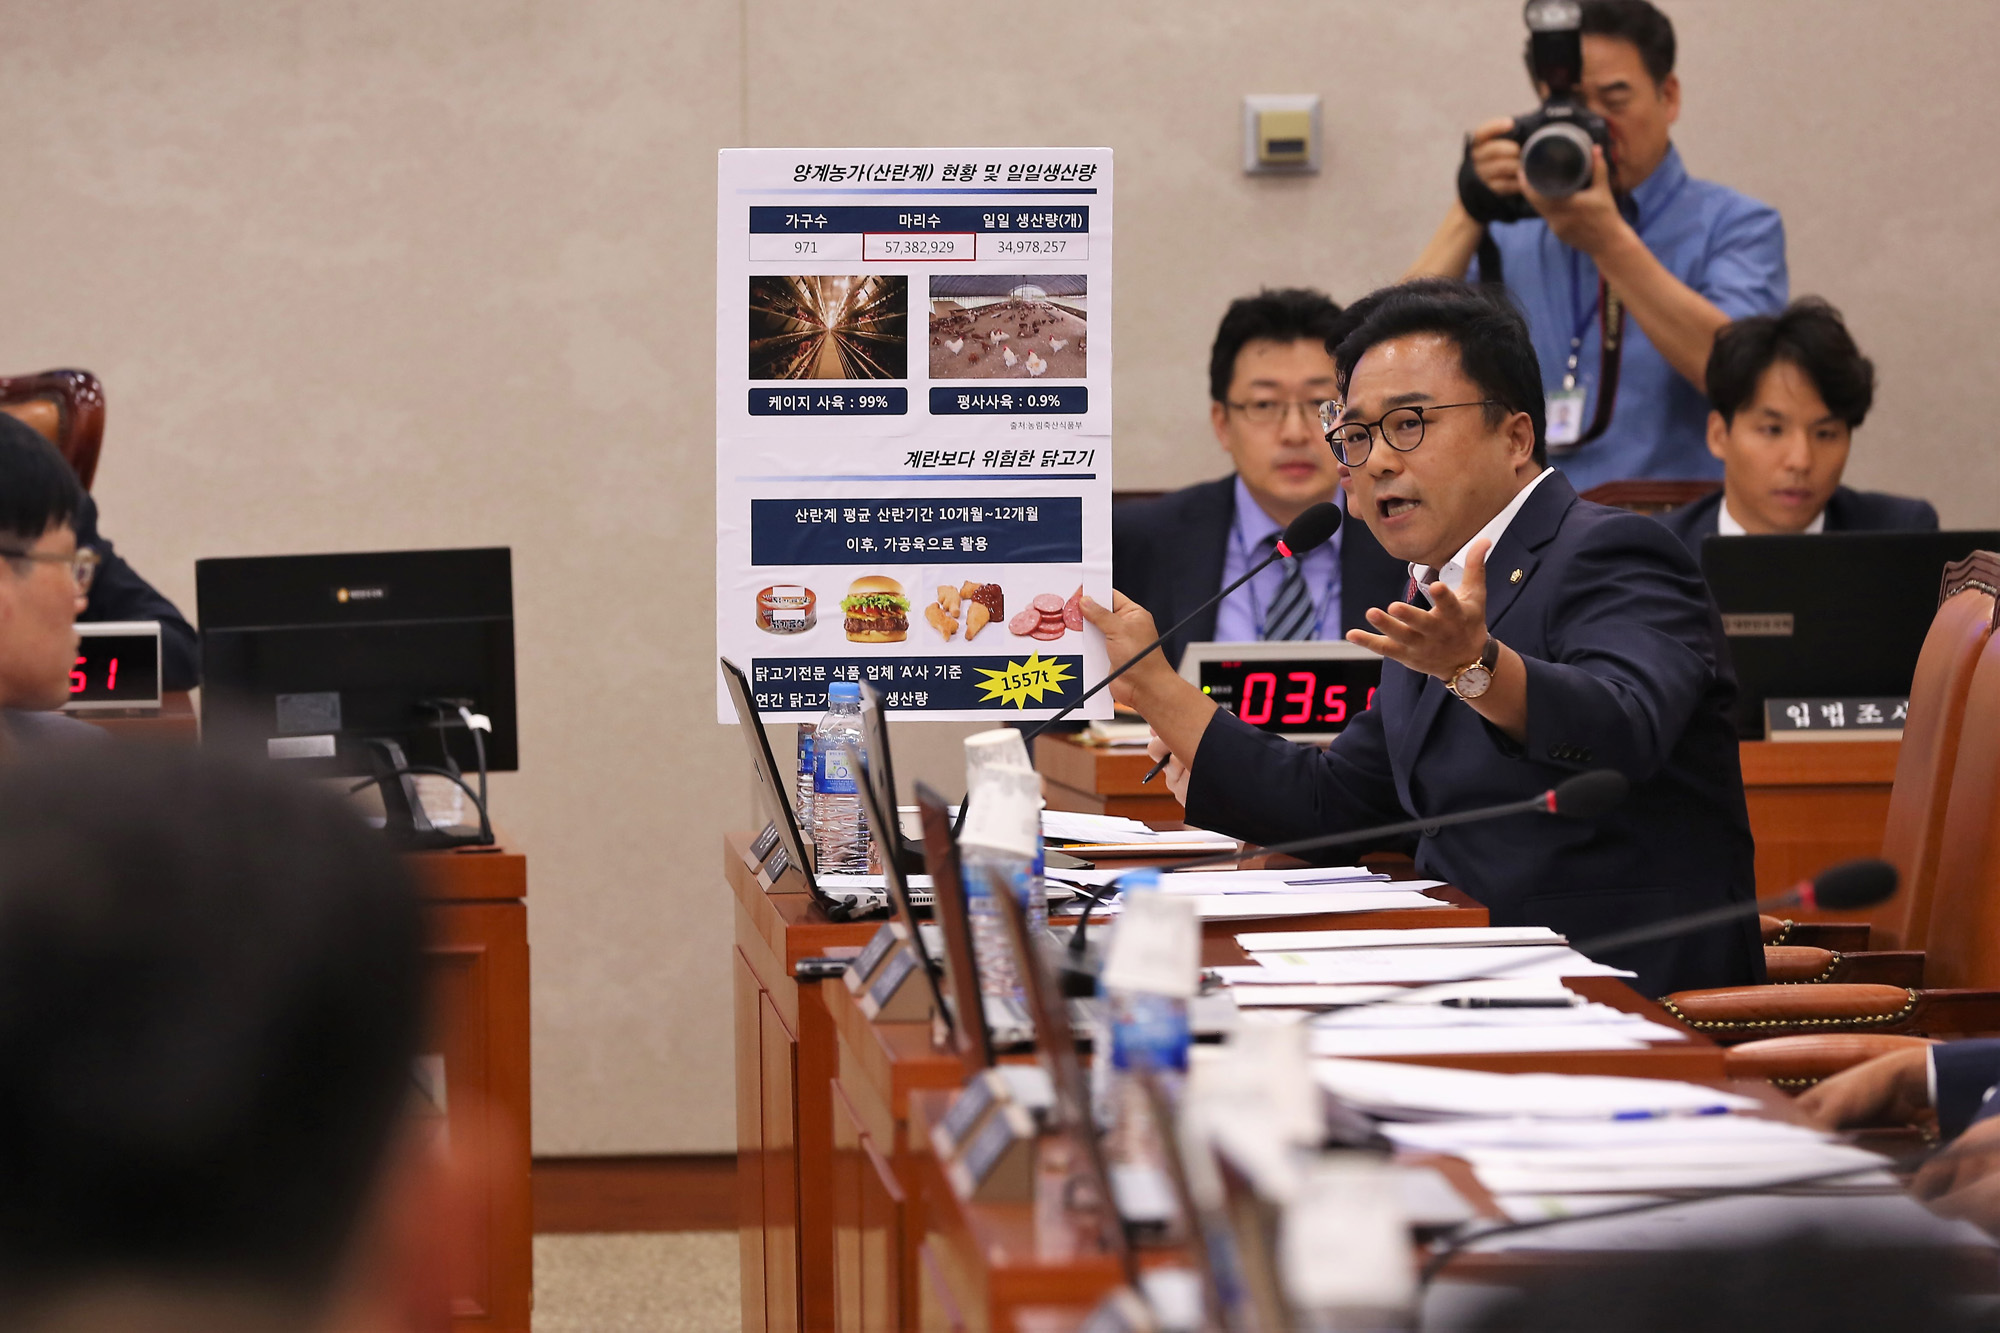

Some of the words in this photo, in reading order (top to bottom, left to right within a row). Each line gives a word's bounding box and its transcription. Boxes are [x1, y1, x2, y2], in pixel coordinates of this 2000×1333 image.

[793, 163, 935, 183] 양계농가(산란계)
[941, 163, 978, 183] 현황
[983, 163, 1002, 182] 및
[1006, 163, 1098, 182] 일일생산량
[785, 213, 828, 229] 가구수
[899, 213, 941, 229] 마리수
[982, 212, 1010, 229] 일일
[1015, 212, 1083, 229] 생산량(개)
[794, 241, 818, 254] 971
[885, 241, 955, 255] 57,382,929
[997, 240, 1067, 254] 34,978,257
[768, 395, 810, 411] 케이지
[816, 395, 845, 411] 사육
[858, 395, 888, 409] 99%
[957, 394, 1014, 410] 평사사육
[1027, 394, 1061, 408] 0.9%
[903, 449, 976, 469] 계란보다
[981, 449, 1036, 468] 위험한
[1040, 449, 1094, 468] 닭고기
[794, 507, 837, 524] 산란계
[843, 507, 872, 523] 평균
[876, 506, 934, 523] 산란기간
[939, 506, 1039, 523] 10개월~12개월
[846, 536, 878, 553] 이후,
[883, 536, 955, 553] 가공육으로
[960, 536, 989, 552] 활용
[755, 665, 827, 682] 닭고기전문
[832, 665, 861, 681] 식품
[866, 664, 894, 681] 업체
[934, 664, 963, 680] 기준
[1001, 670, 1050, 692] 1557t
[755, 692, 784, 708] 연간
[885, 691, 929, 707] 생산량
